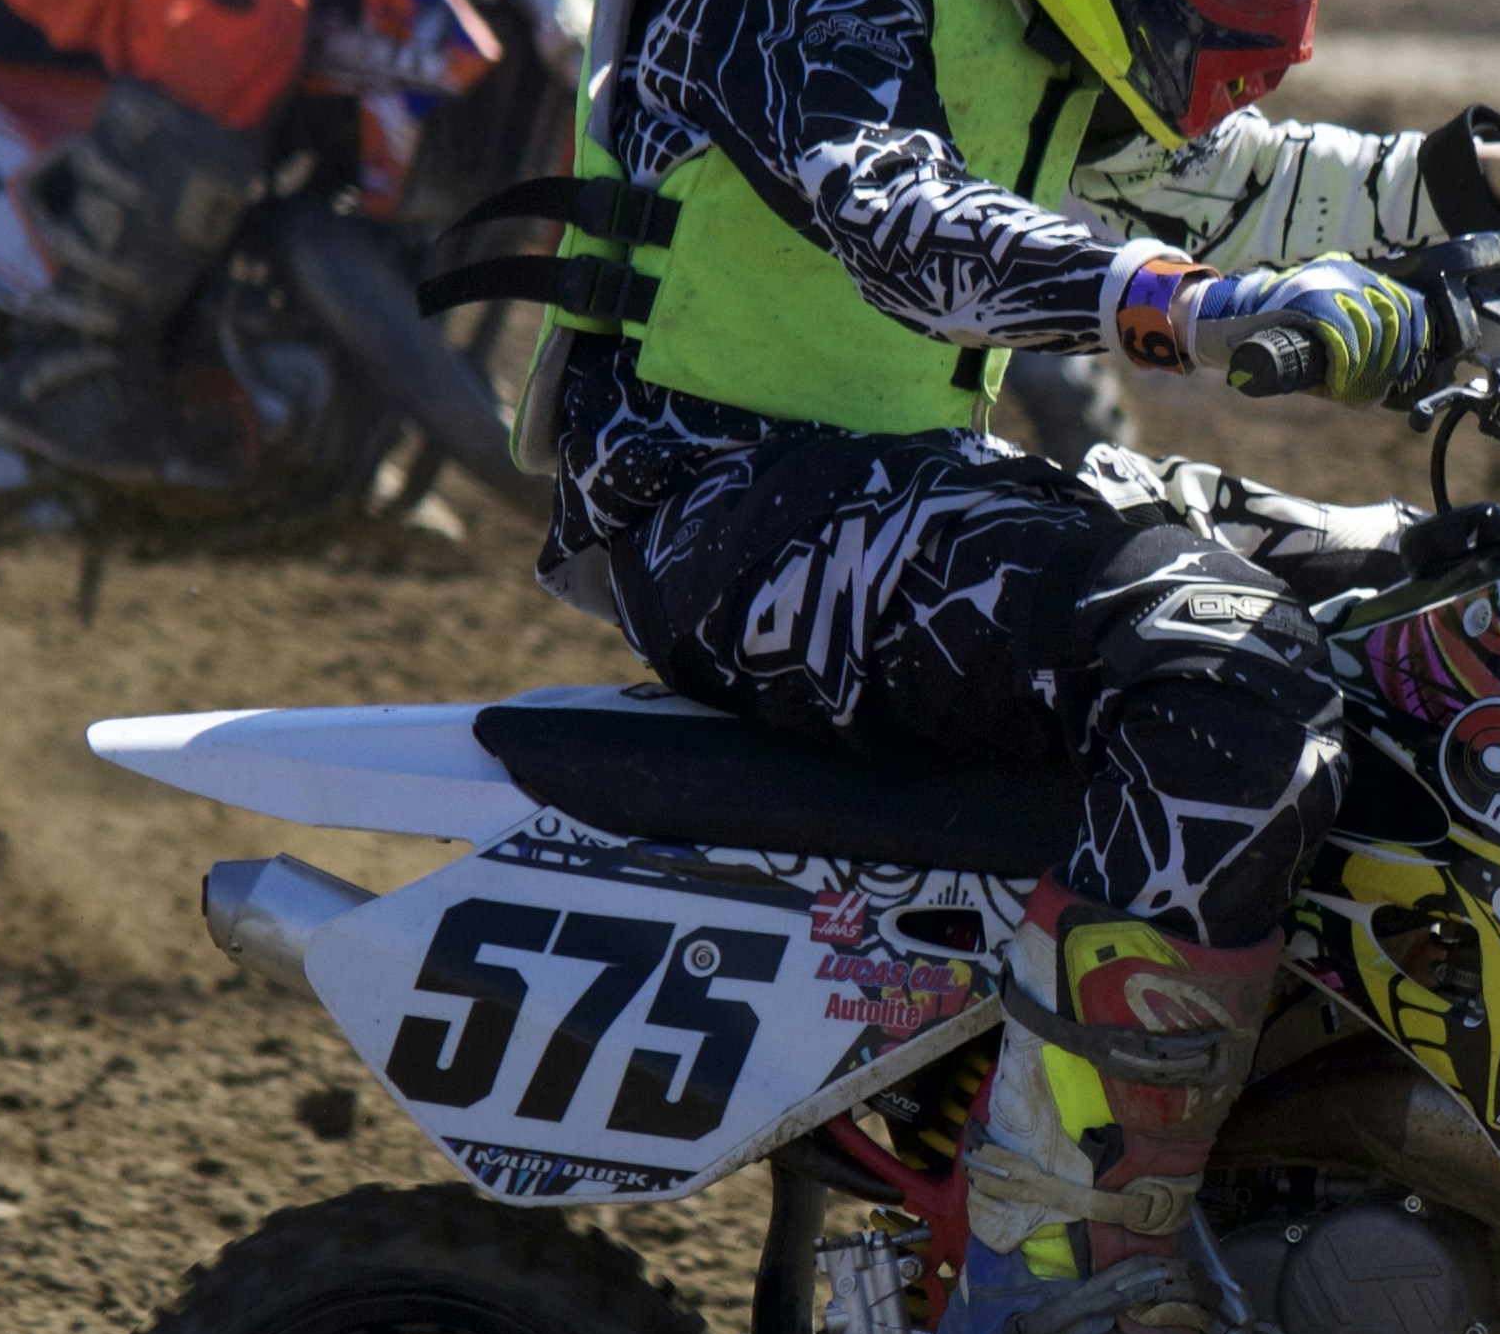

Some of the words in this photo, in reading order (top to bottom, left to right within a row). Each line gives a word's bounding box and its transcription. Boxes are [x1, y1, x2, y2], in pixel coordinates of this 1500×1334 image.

[815, 954, 910, 990] LUCAS
[909, 966, 956, 995] OIL
[385, 896, 791, 1141] 575
[824, 992, 922, 1028] Autolite
[473, 1149, 552, 1174] MUD
[561, 1162, 651, 1188] DUCK
